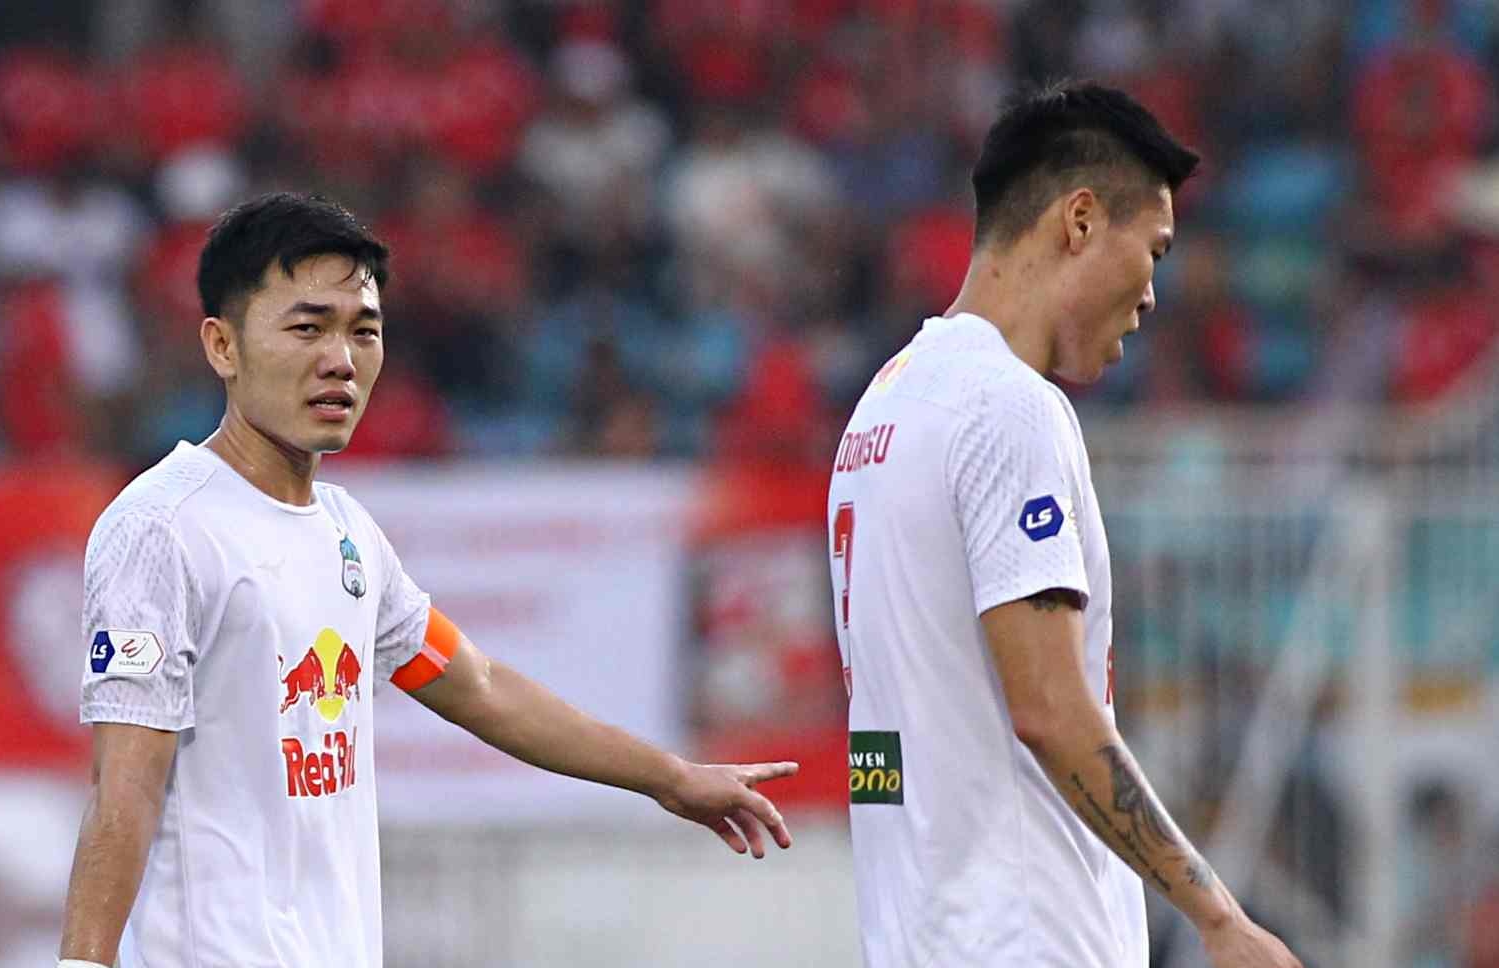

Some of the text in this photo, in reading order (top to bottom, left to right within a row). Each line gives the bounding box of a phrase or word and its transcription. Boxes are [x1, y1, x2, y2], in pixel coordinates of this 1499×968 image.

[1026, 508, 1053, 530] LS
[92, 644, 108, 660] LS
[281, 733, 338, 798] Red
